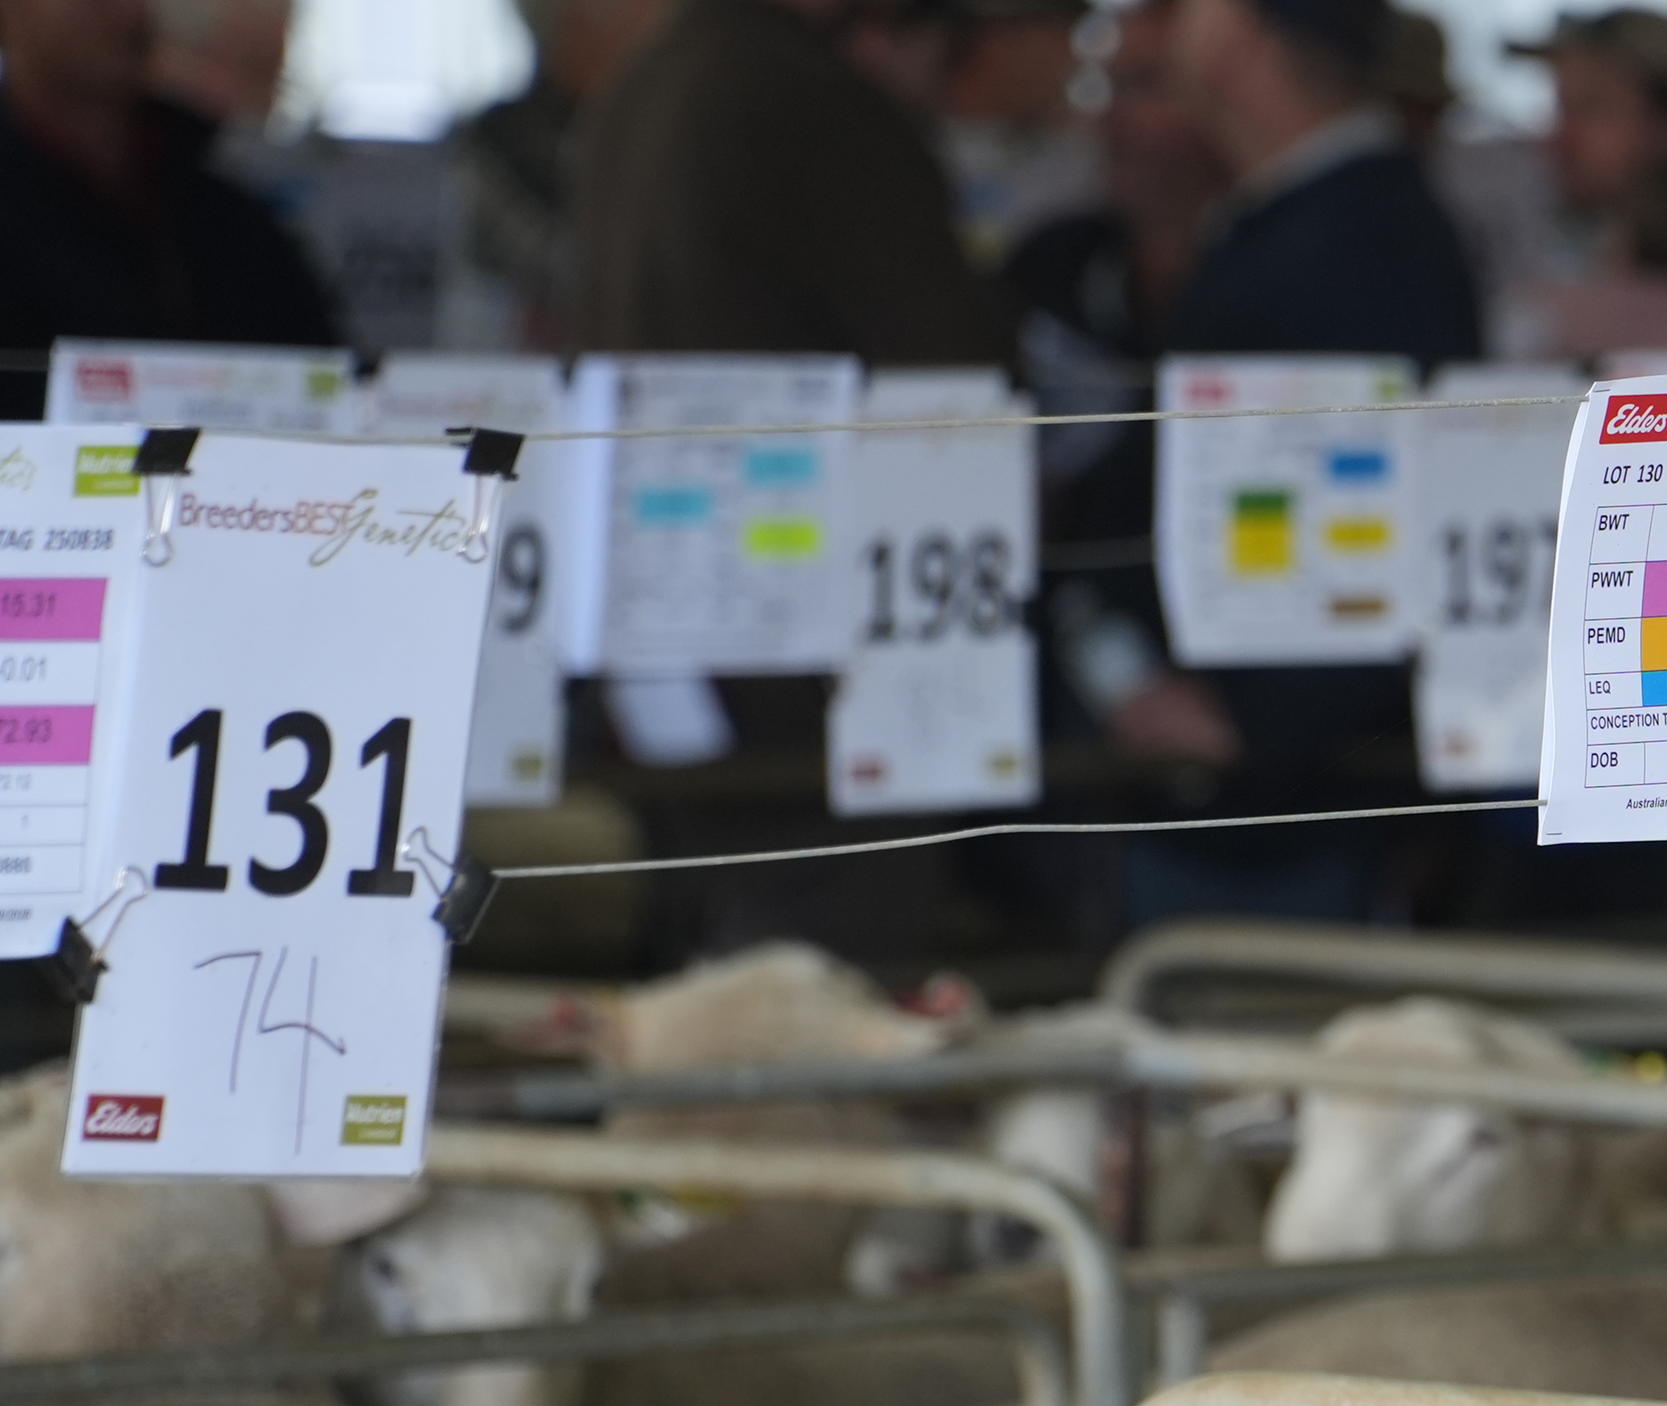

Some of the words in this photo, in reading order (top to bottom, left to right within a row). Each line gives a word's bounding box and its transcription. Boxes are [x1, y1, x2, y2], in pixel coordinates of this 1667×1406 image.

[1603, 465, 1631, 485] LOT
[1637, 463, 1664, 484] 130
[1598, 514, 1629, 532] BWT
[862, 530, 1012, 644] 198
[1591, 571, 1634, 589] PWWT
[1587, 627, 1626, 645] PEMD
[1588, 681, 1612, 695] LEQ
[1591, 713, 1660, 730] CONCEPTION
[1590, 752, 1619, 769] DOB
[153, 708, 415, 898] 131
[193, 946, 346, 1156] 74
